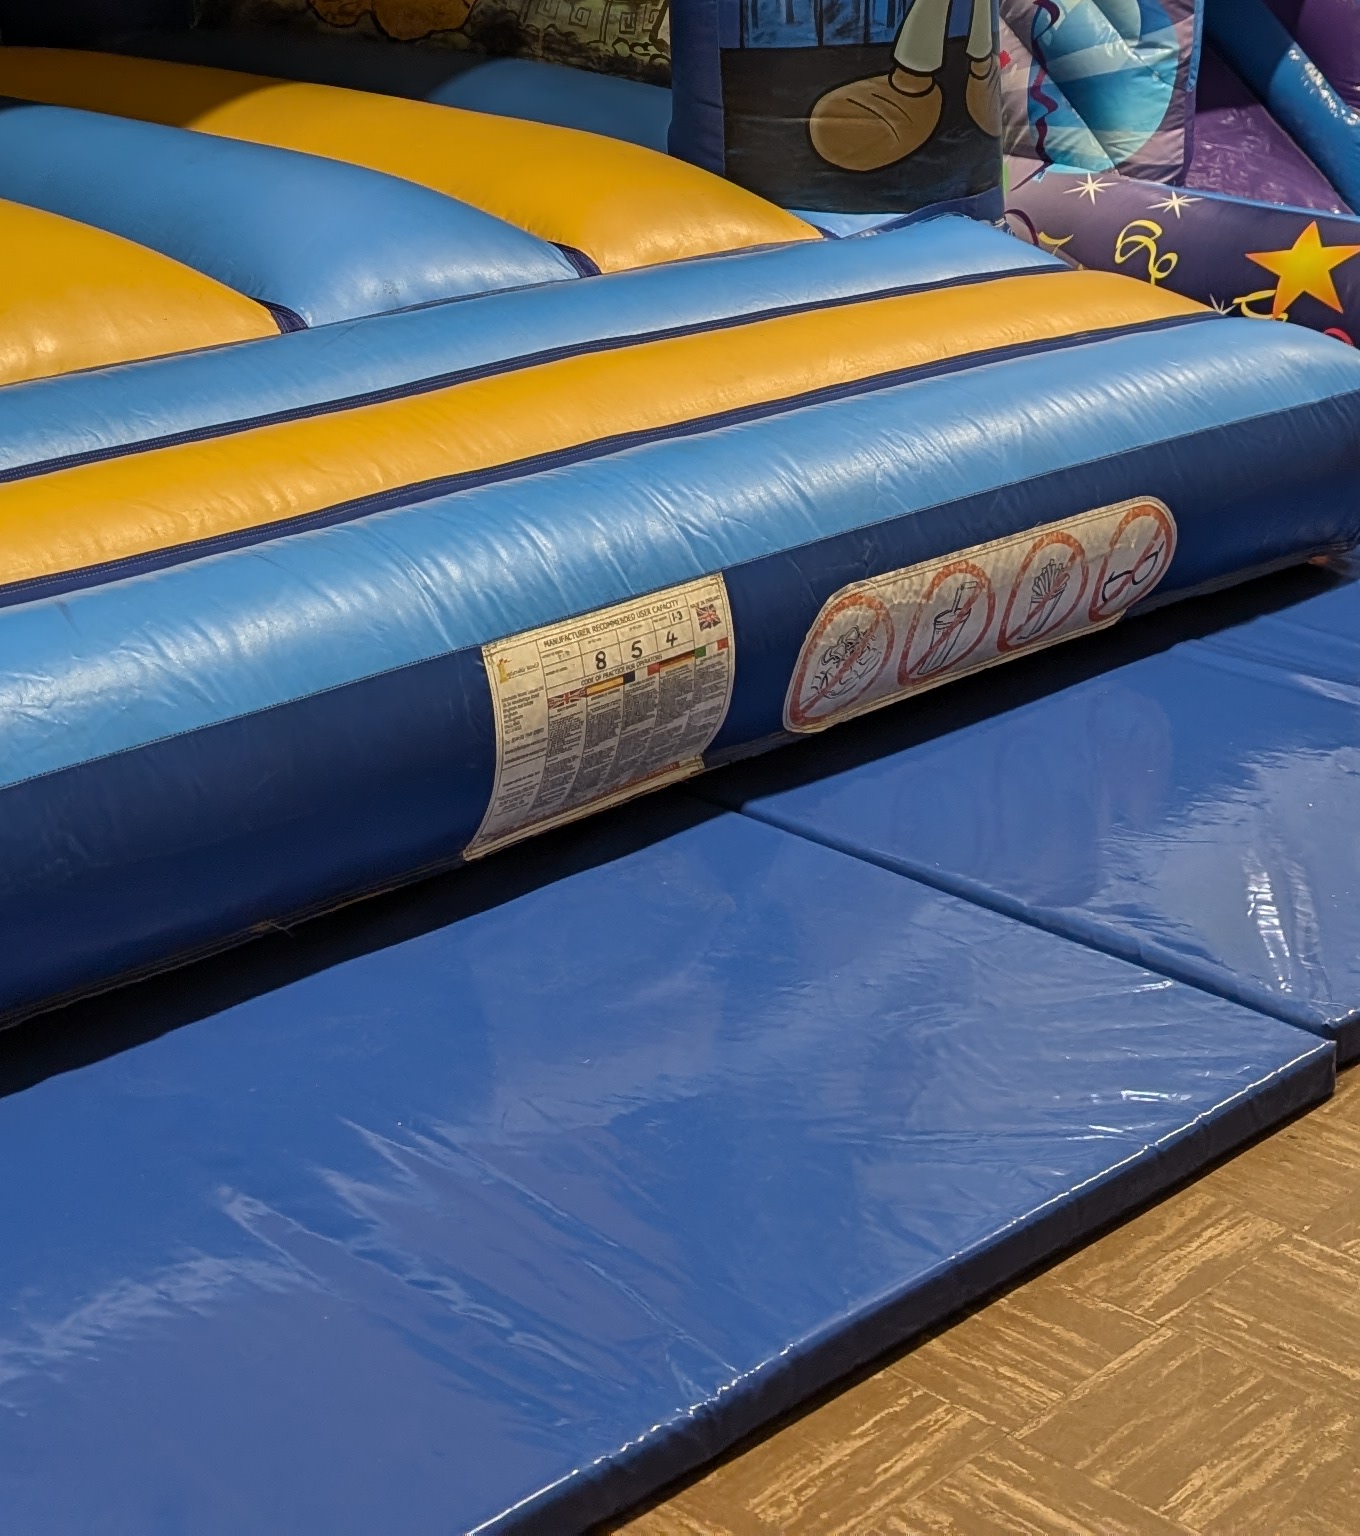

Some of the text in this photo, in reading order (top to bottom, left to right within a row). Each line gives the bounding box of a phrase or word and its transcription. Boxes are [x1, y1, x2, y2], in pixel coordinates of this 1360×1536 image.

[543, 627, 591, 648] MANUFACTURER
[592, 614, 635, 633] RECOMMENDED
[636, 607, 652, 618] USER
[652, 599, 679, 614] CAPACITY
[595, 630, 678, 670] 8 5 4
